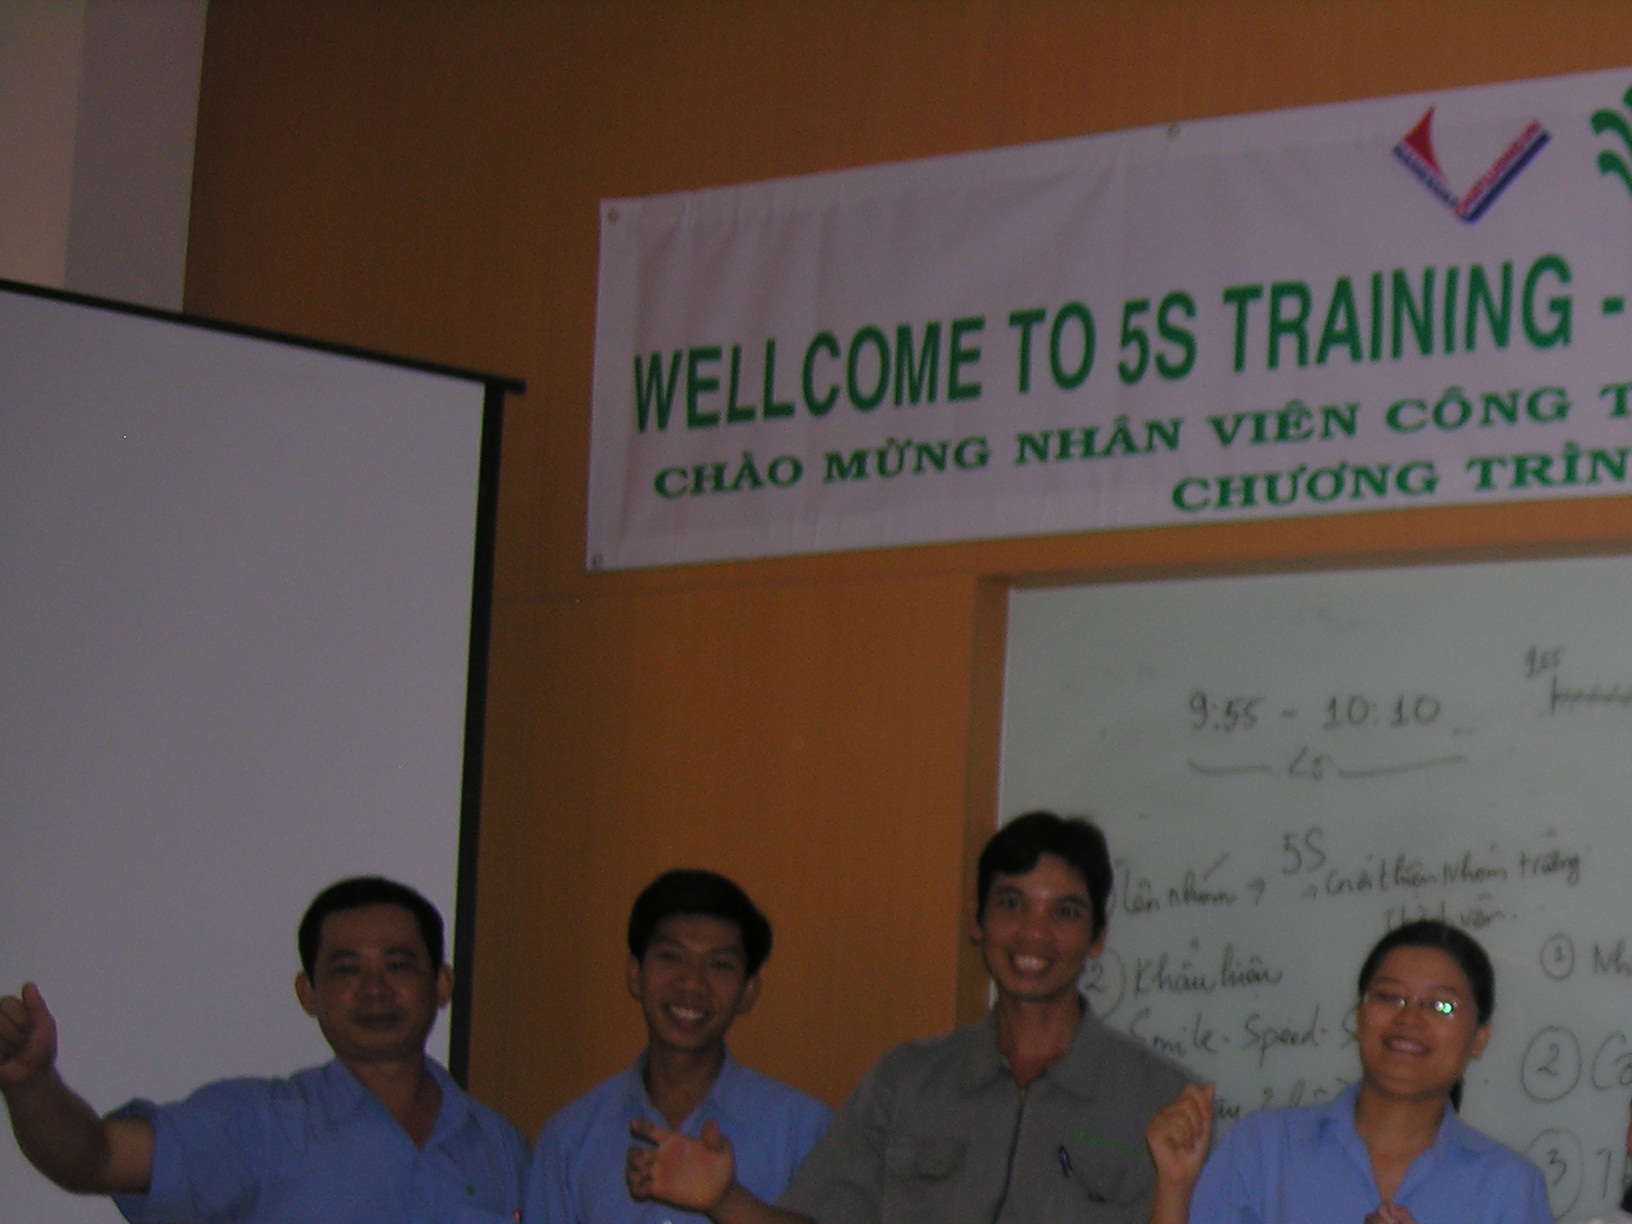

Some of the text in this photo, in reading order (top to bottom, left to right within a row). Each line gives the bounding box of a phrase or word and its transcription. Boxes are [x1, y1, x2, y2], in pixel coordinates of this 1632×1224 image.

[635, 316, 984, 430] WELLCOME
[1007, 300, 1098, 394] TO
[1116, 289, 1198, 386] 5S
[1222, 252, 1573, 373] TRAINING
[652, 448, 804, 498] CHÀO
[823, 435, 990, 483] MỪNG
[1015, 416, 1183, 465] NHÂN
[1208, 399, 1358, 447] VIÊN
[1384, 386, 1572, 433] CÔNG
[1170, 461, 1440, 512] CHƯƠNG
[1281, 826, 1328, 876] 5S
